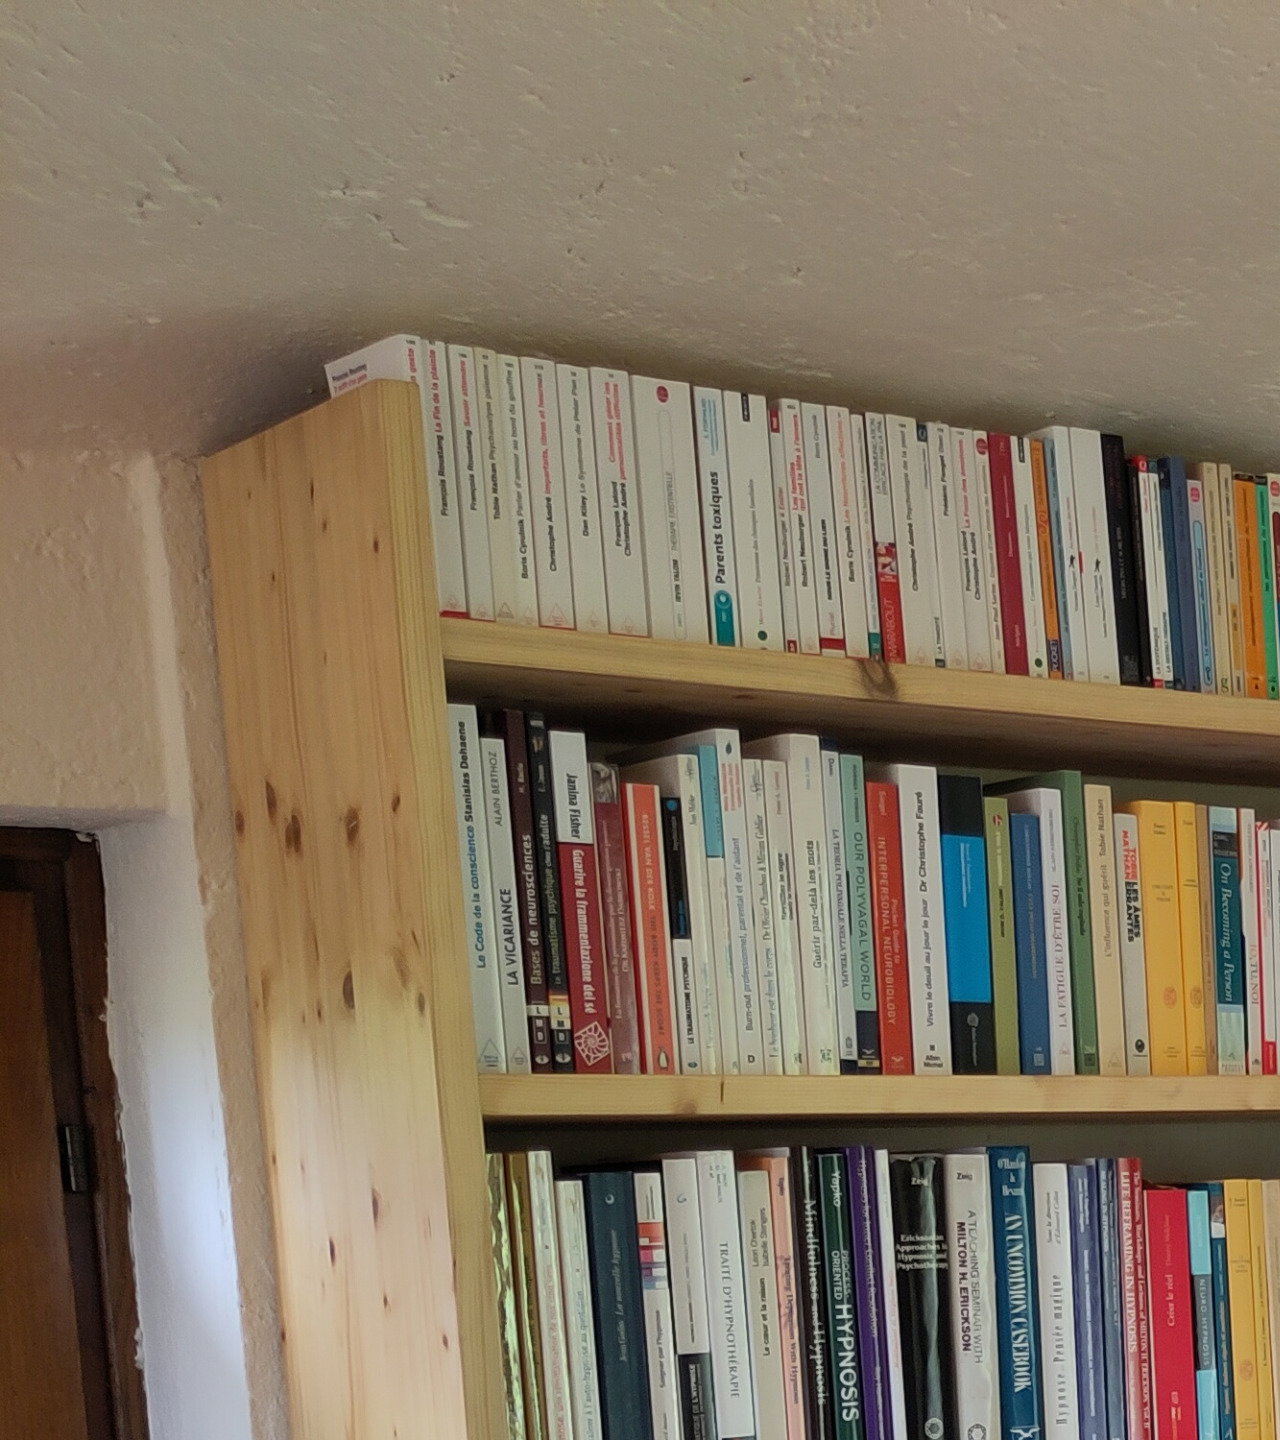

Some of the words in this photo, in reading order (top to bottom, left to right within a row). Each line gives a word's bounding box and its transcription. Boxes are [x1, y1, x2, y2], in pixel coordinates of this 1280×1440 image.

[708, 470, 725, 531] toxiques
[712, 533, 727, 585] Parents
[520, 833, 538, 927] neurosciences
[806, 839, 816, 867] mots
[498, 887, 518, 967] VICARIANCE
[810, 929, 824, 969] Guérir
[507, 971, 519, 986] LA
[529, 949, 543, 985] Bases
[957, 1220, 970, 1267] MILTON
[1004, 1211, 1022, 1229] AN
[719, 1241, 735, 1282] TRAITÉ
[1006, 1232, 1028, 1315] UNCOMMON
[722, 1286, 741, 1399] D'HYPNOTHÉRAPIE
[958, 1283, 973, 1352] ERICKSON
[834, 1302, 863, 1421] HYPNOSIS
[1009, 1316, 1033, 1393] CASEBOOK
